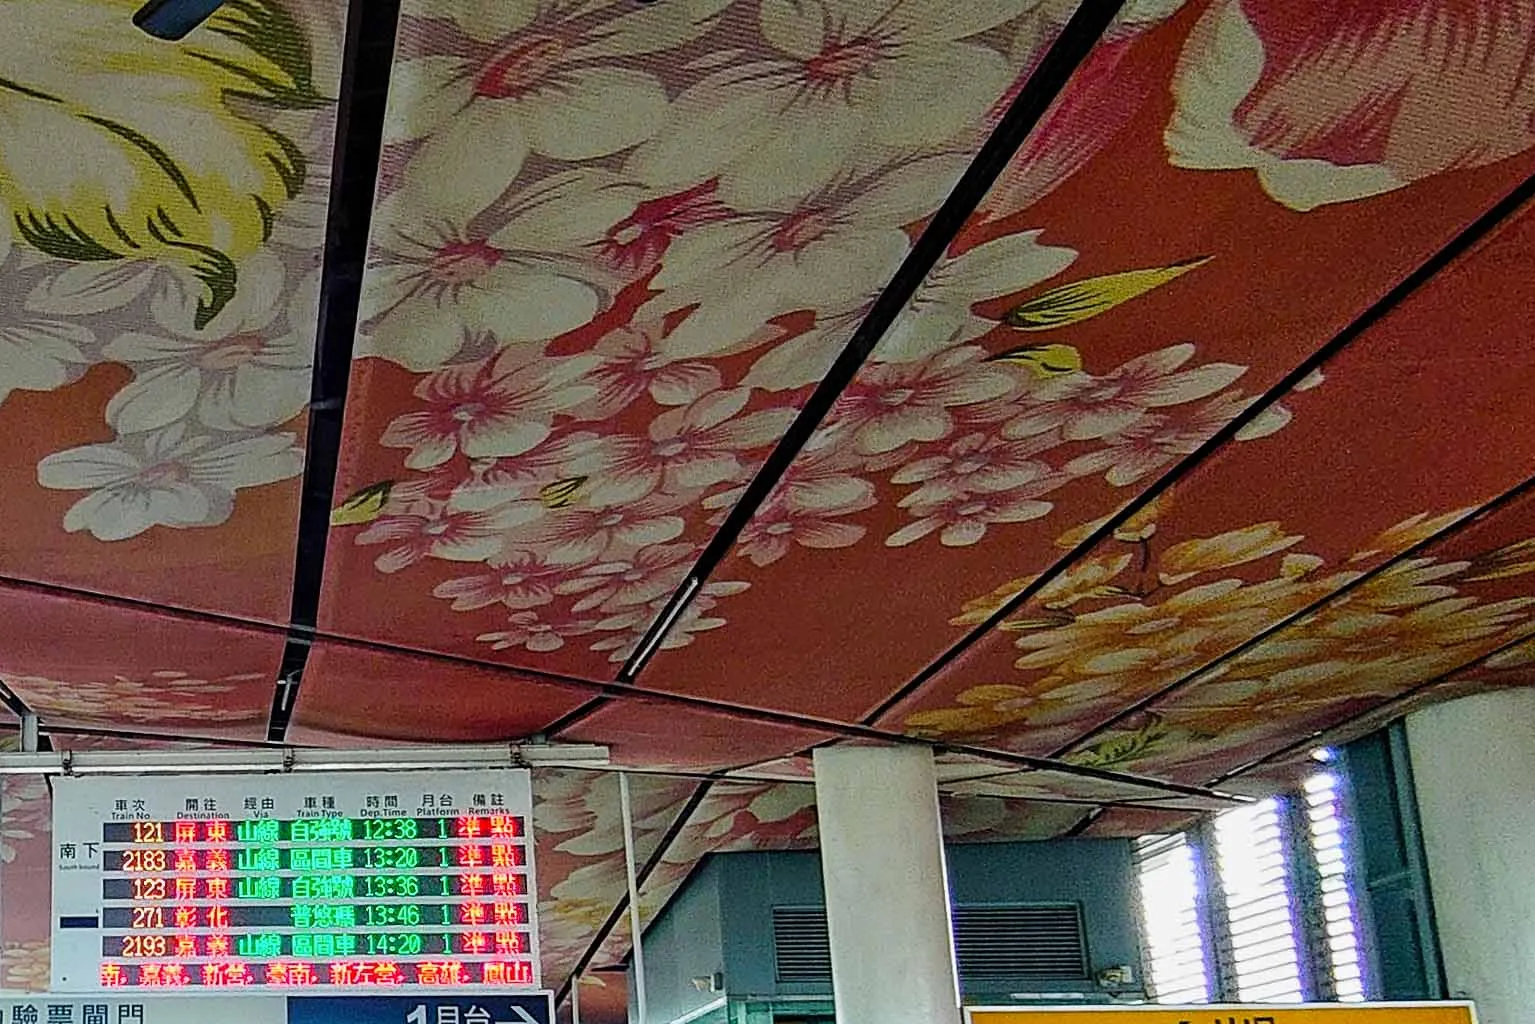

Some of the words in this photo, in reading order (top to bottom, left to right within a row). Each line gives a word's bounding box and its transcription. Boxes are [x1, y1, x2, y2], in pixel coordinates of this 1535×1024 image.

[111, 812, 135, 820] Train
[177, 811, 230, 820] Destination
[254, 811, 268, 819] Via
[297, 809, 319, 817] Train
[321, 809, 343, 818] Type
[417, 807, 460, 816] Platform
[468, 807, 510, 816] Remarks
[115, 800, 146, 811] 車次
[186, 799, 217, 811] 開往
[244, 798, 274, 810] 經由
[304, 796, 335, 808] 車種
[367, 795, 398, 808] 時間
[422, 794, 453, 807] 月台
[473, 793, 504, 806] 備註
[134, 822, 163, 843] 121
[175, 822, 227, 843] 屏東
[237, 820, 279, 842] 山線
[291, 819, 353, 841] 自強號
[364, 819, 417, 839] 12:38
[438, 819, 448, 839] 1
[59, 842, 99, 859] 南下
[122, 850, 166, 871] 2183
[175, 849, 228, 871] 嘉義
[238, 848, 279, 870] 山線
[291, 847, 353, 869] 區間車
[364, 847, 417, 868] 13:20
[439, 847, 449, 868] 1
[134, 878, 165, 899] 123
[175, 878, 228, 900] 屏東
[238, 877, 280, 898] 山線
[292, 876, 354, 898] 自強號
[365, 876, 419, 897] 13:36
[440, 876, 450, 896] 1
[132, 907, 163, 928] 271
[175, 906, 229, 928] 彰化
[366, 904, 420, 925] 13:46
[441, 904, 451, 925] 1
[122, 936, 166, 957] 2193
[239, 934, 280, 956] 山線
[292, 934, 355, 956] 區間車
[367, 933, 421, 954] 14:20
[442, 933, 452, 954] 1
